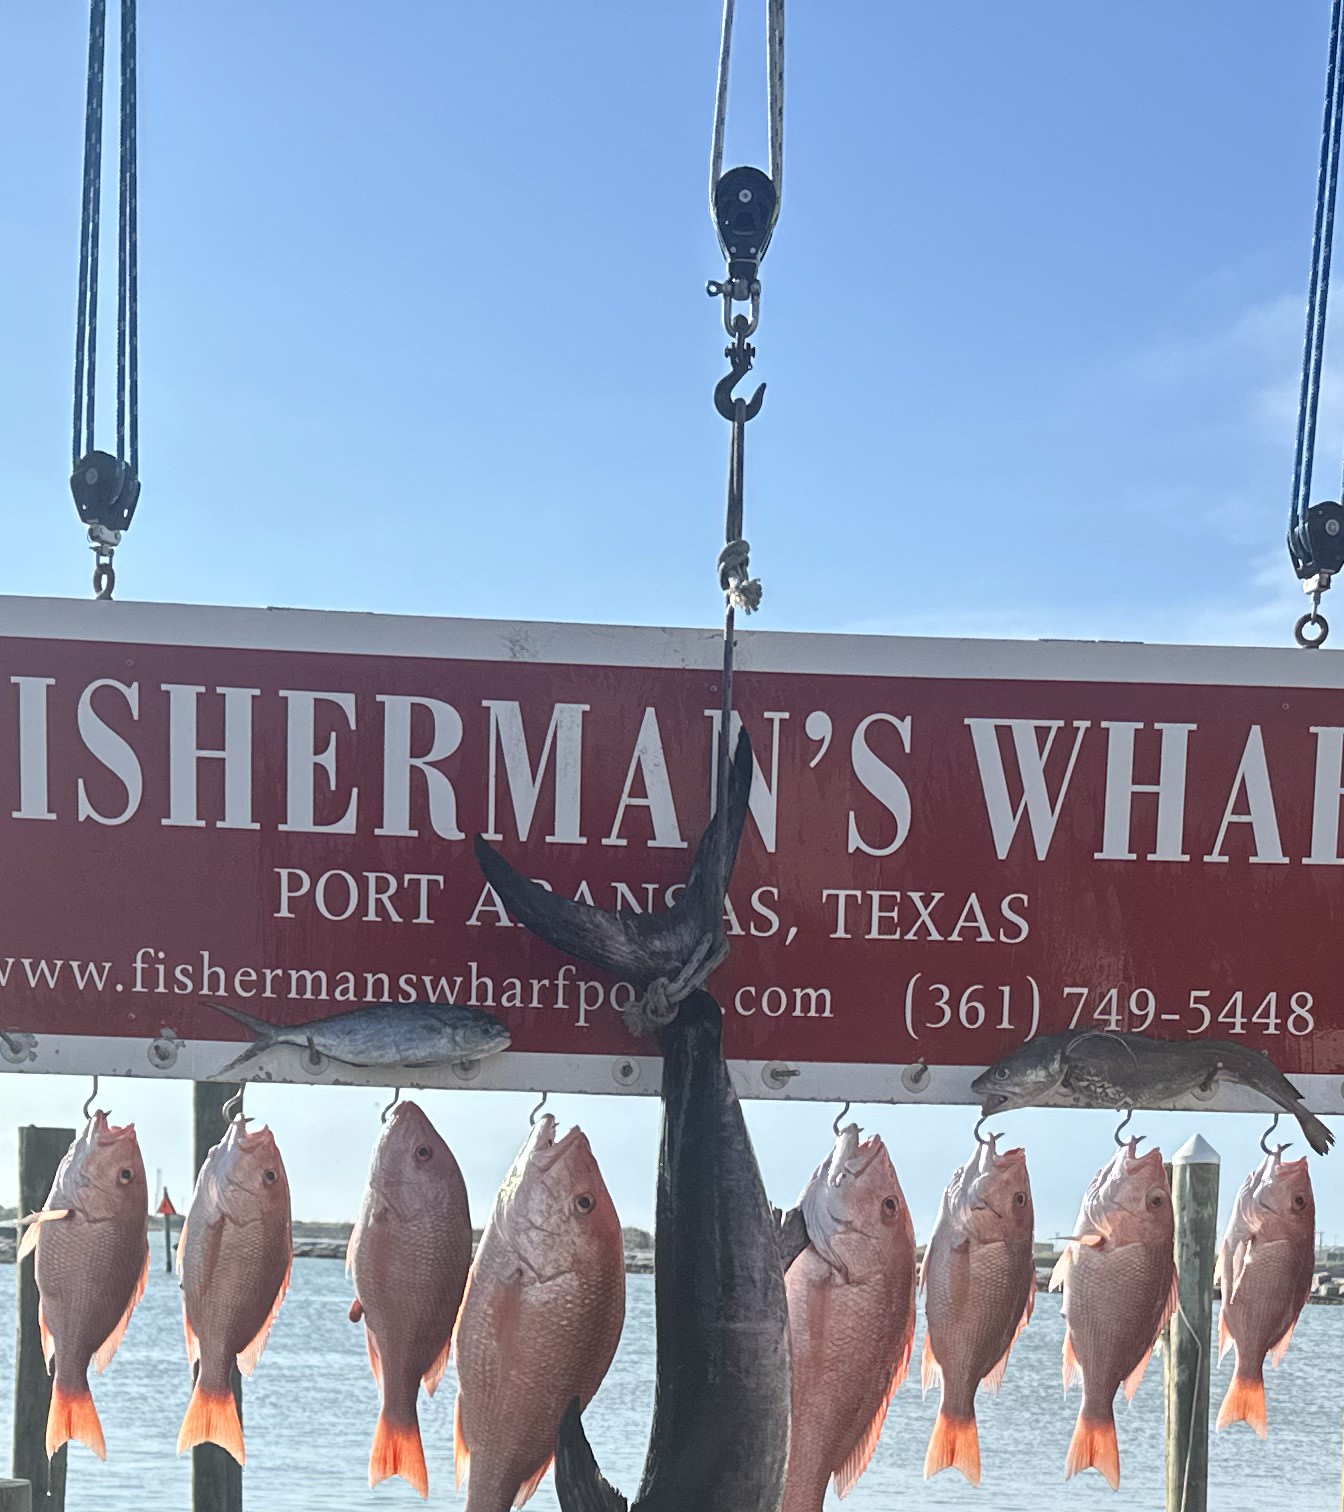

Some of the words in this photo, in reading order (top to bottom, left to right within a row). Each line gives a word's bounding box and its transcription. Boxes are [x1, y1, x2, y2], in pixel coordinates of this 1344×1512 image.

[273, 867, 443, 925] PORT
[465, 879, 798, 945] ANAS,
[823, 889, 1031, 944] TEXAS
[904, 972, 1041, 1041] (361)
[1062, 986, 1316, 1036] 749-5448
